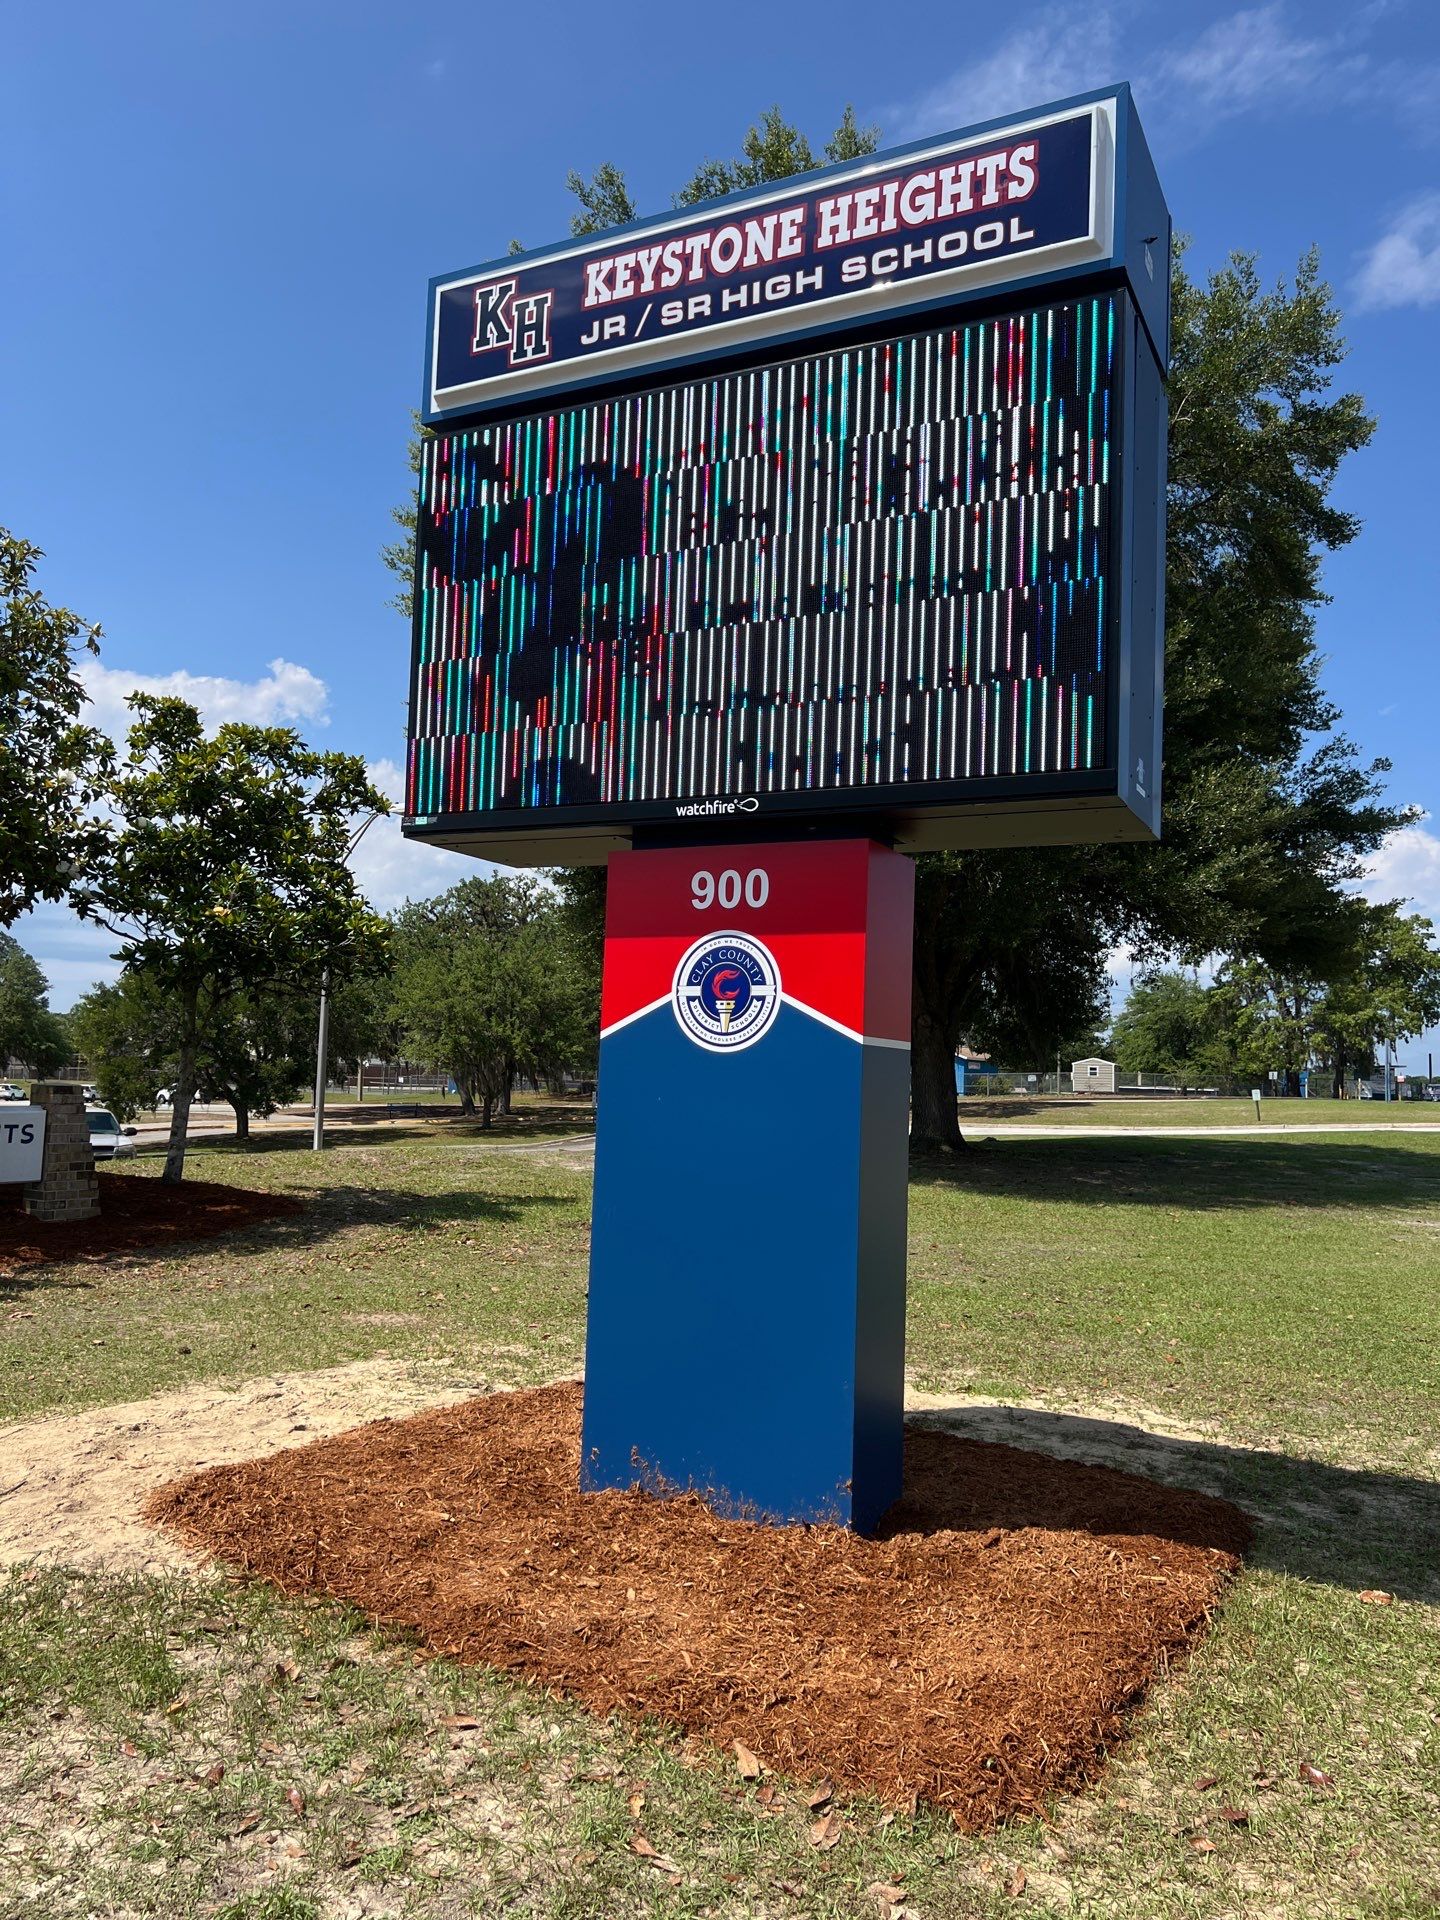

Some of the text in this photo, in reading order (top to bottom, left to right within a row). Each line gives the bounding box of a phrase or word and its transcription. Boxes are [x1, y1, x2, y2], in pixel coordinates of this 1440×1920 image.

[583, 144, 1036, 308] KEYSTONE HEIGHTS
[580, 315, 626, 346] JR
[660, 294, 712, 327] SR
[722, 265, 824, 313] HIGH
[841, 216, 1035, 283] SCHOOL
[675, 799, 736, 817] watchfire
[690, 868, 770, 910] 900
[691, 949, 763, 983] CLAY COUNTY
[692, 1004, 759, 1030] DISTRICT SCHOOLS
[0, 1123, 35, 1145] TS
